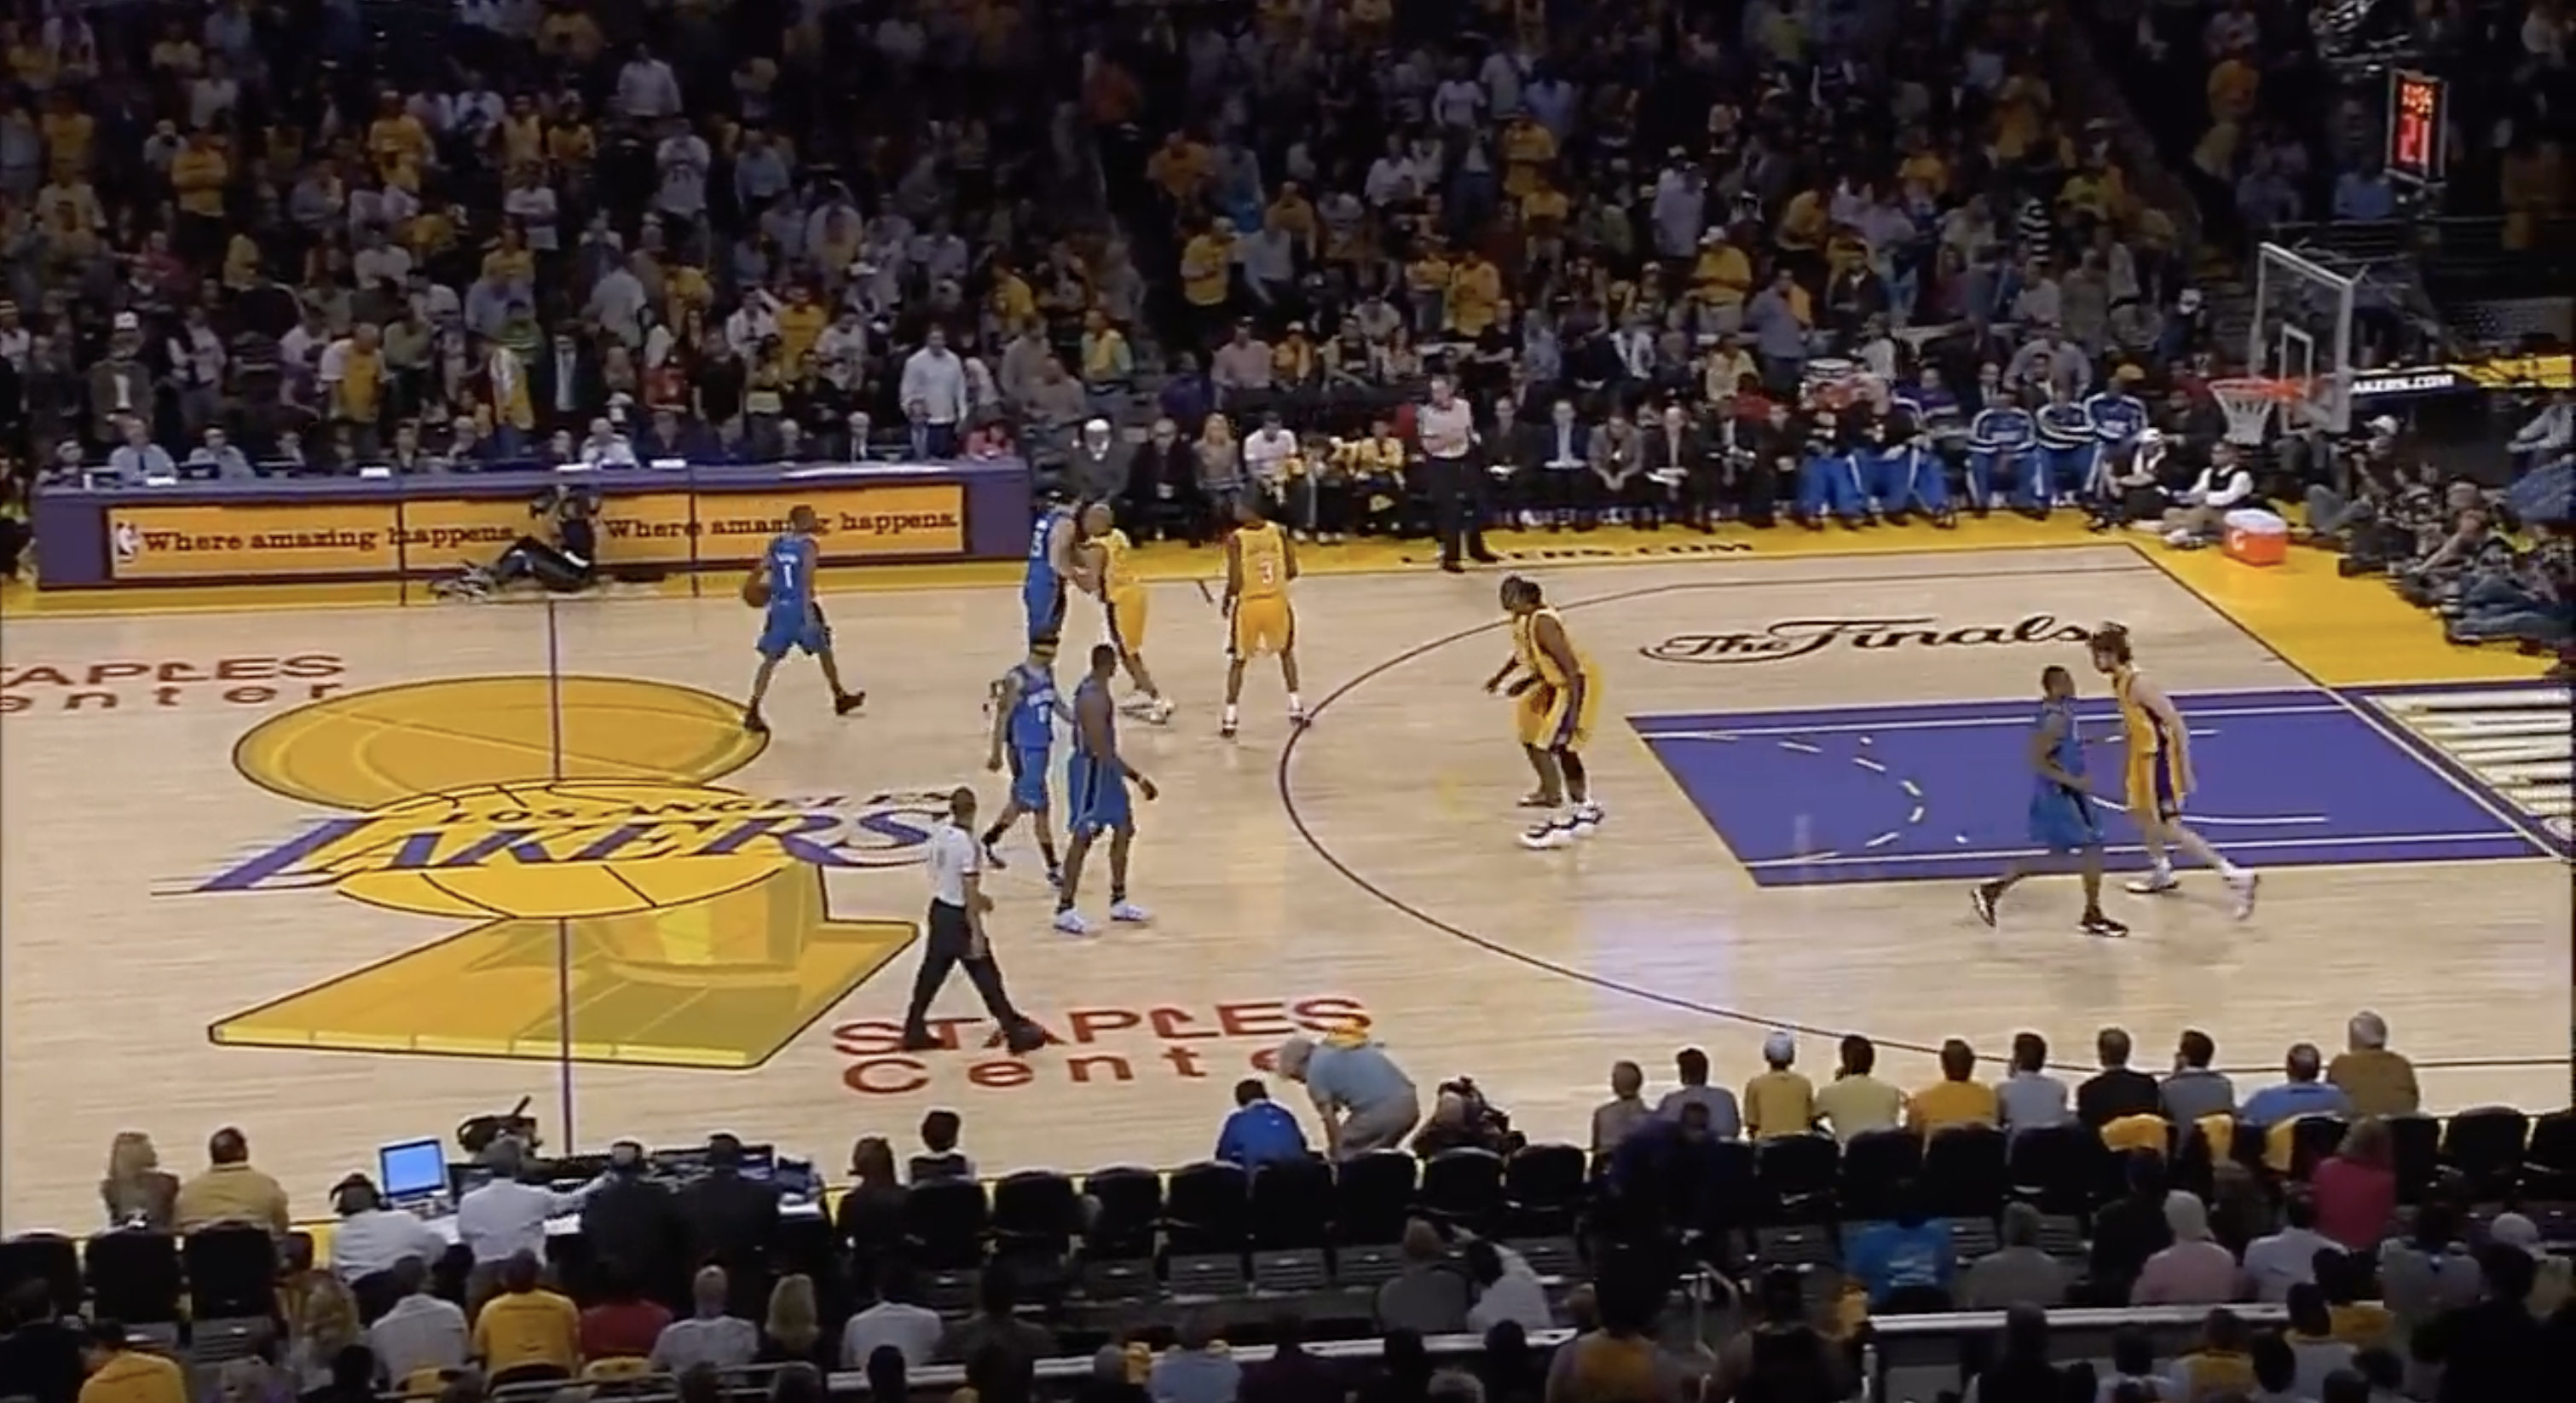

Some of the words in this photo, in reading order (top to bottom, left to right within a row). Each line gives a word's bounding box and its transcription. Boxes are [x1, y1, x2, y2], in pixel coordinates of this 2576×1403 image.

[142, 531, 243, 551] Where
[250, 528, 377, 551] amazing
[603, 519, 702, 538] Where
[712, 517, 832, 537] amazg
[783, 563, 794, 588] 1
[1257, 561, 1274, 584] 3
[1649, 632, 1789, 659] The
[1767, 615, 2092, 660] Finals
[0, 655, 345, 688] APLES
[440, 808, 580, 824] LOS
[162, 808, 948, 892] LAKERS
